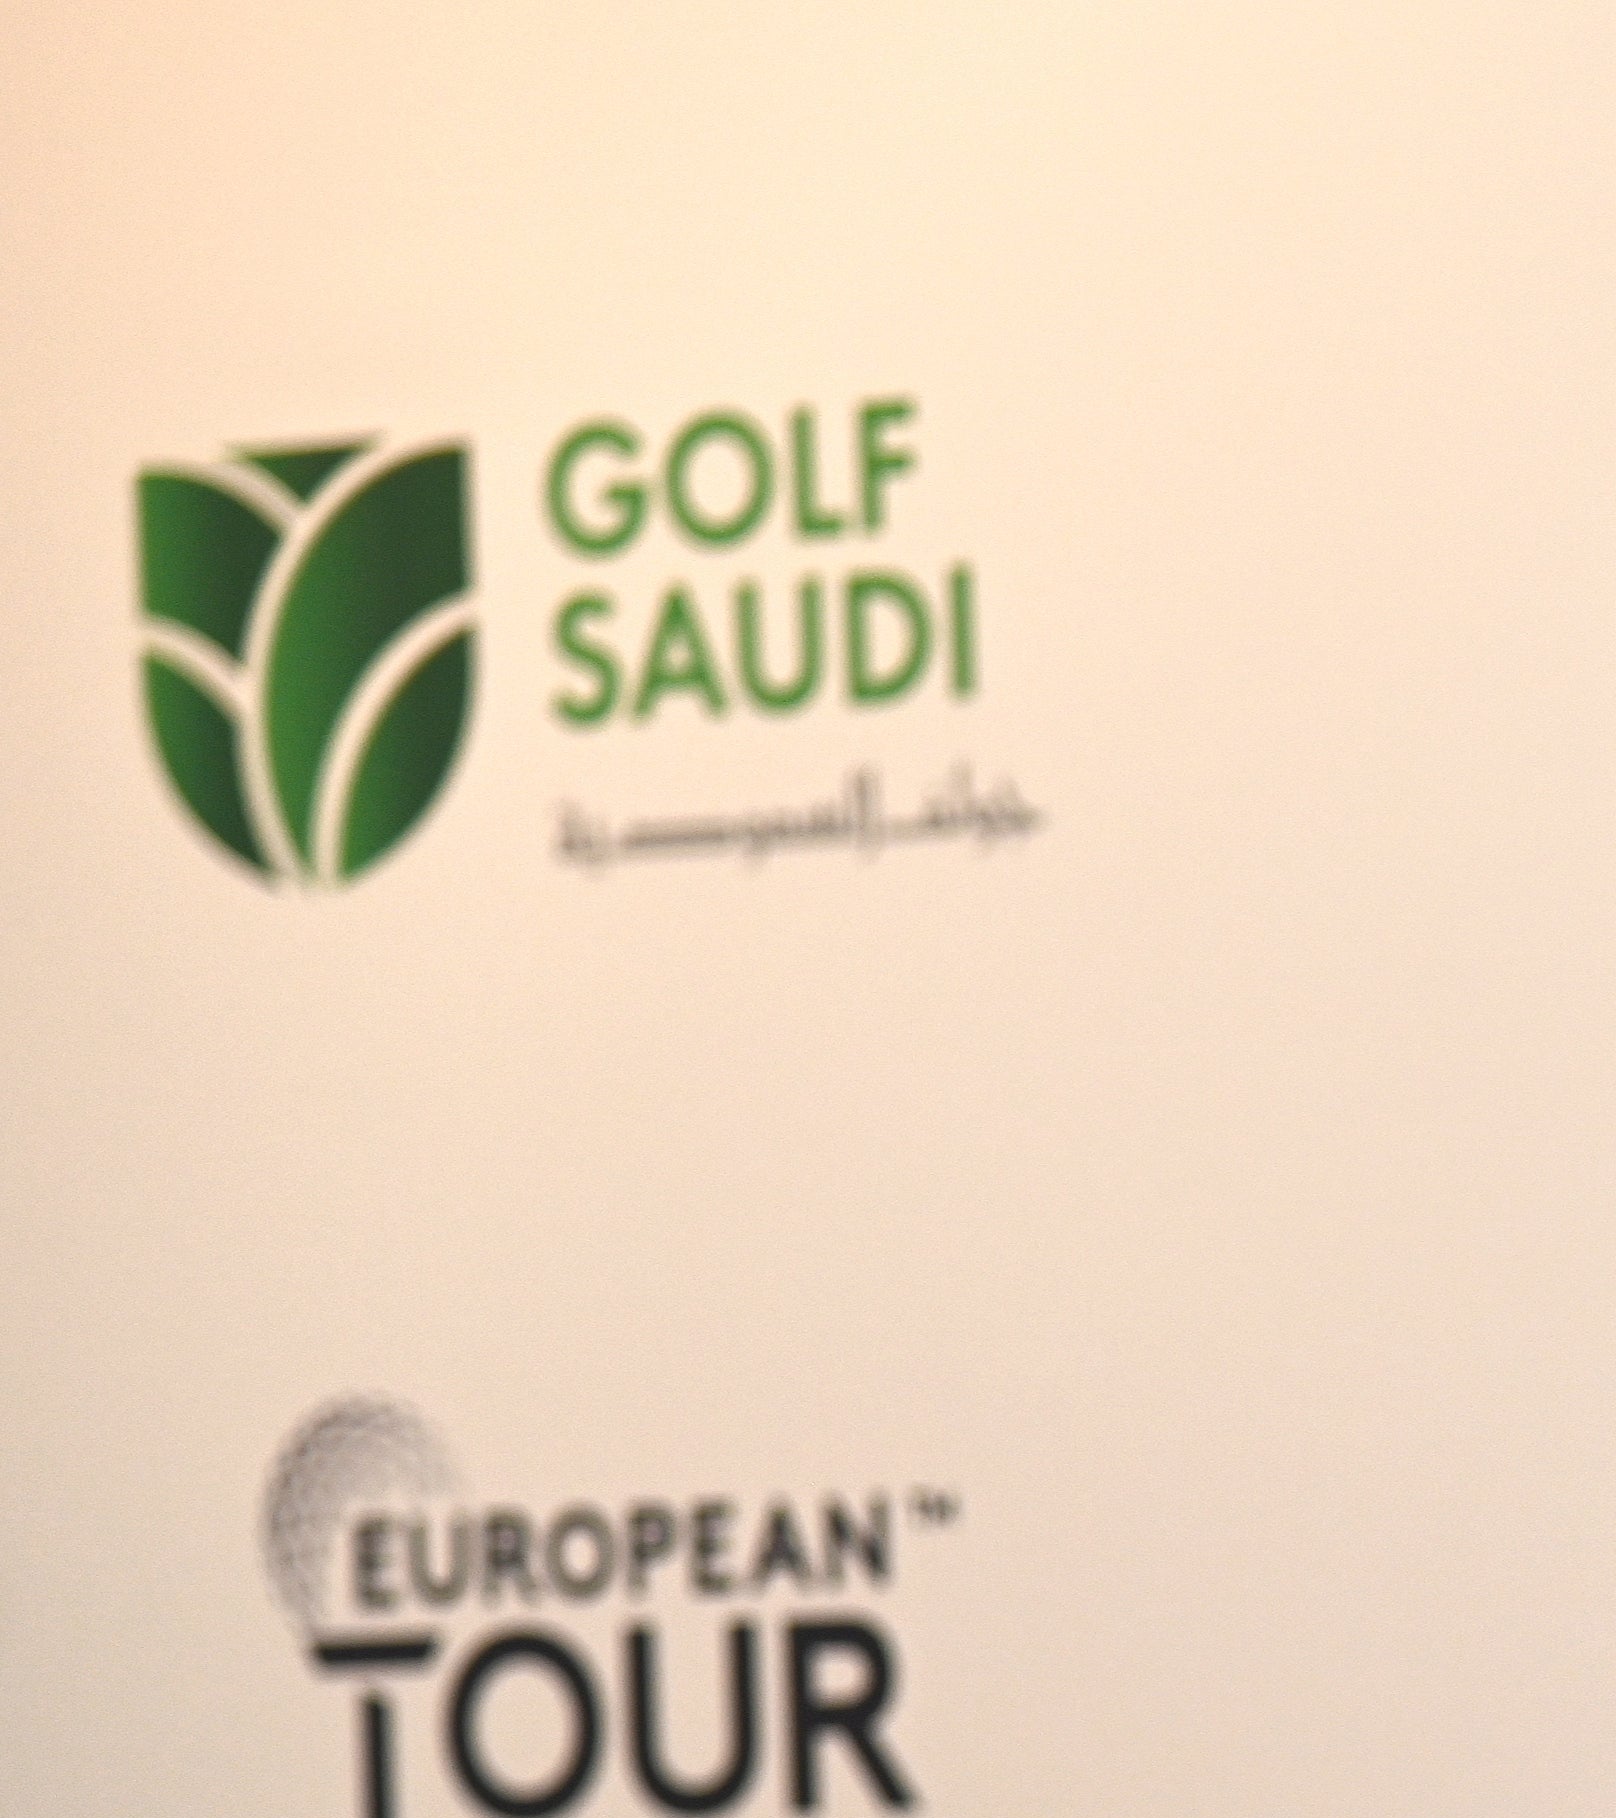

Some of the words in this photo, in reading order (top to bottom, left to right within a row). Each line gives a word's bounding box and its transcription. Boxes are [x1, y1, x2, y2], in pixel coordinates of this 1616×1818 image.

[544, 396, 915, 558] GOLF
[545, 562, 978, 732] SAUDI
[349, 1488, 895, 1611] EUROPEAN
